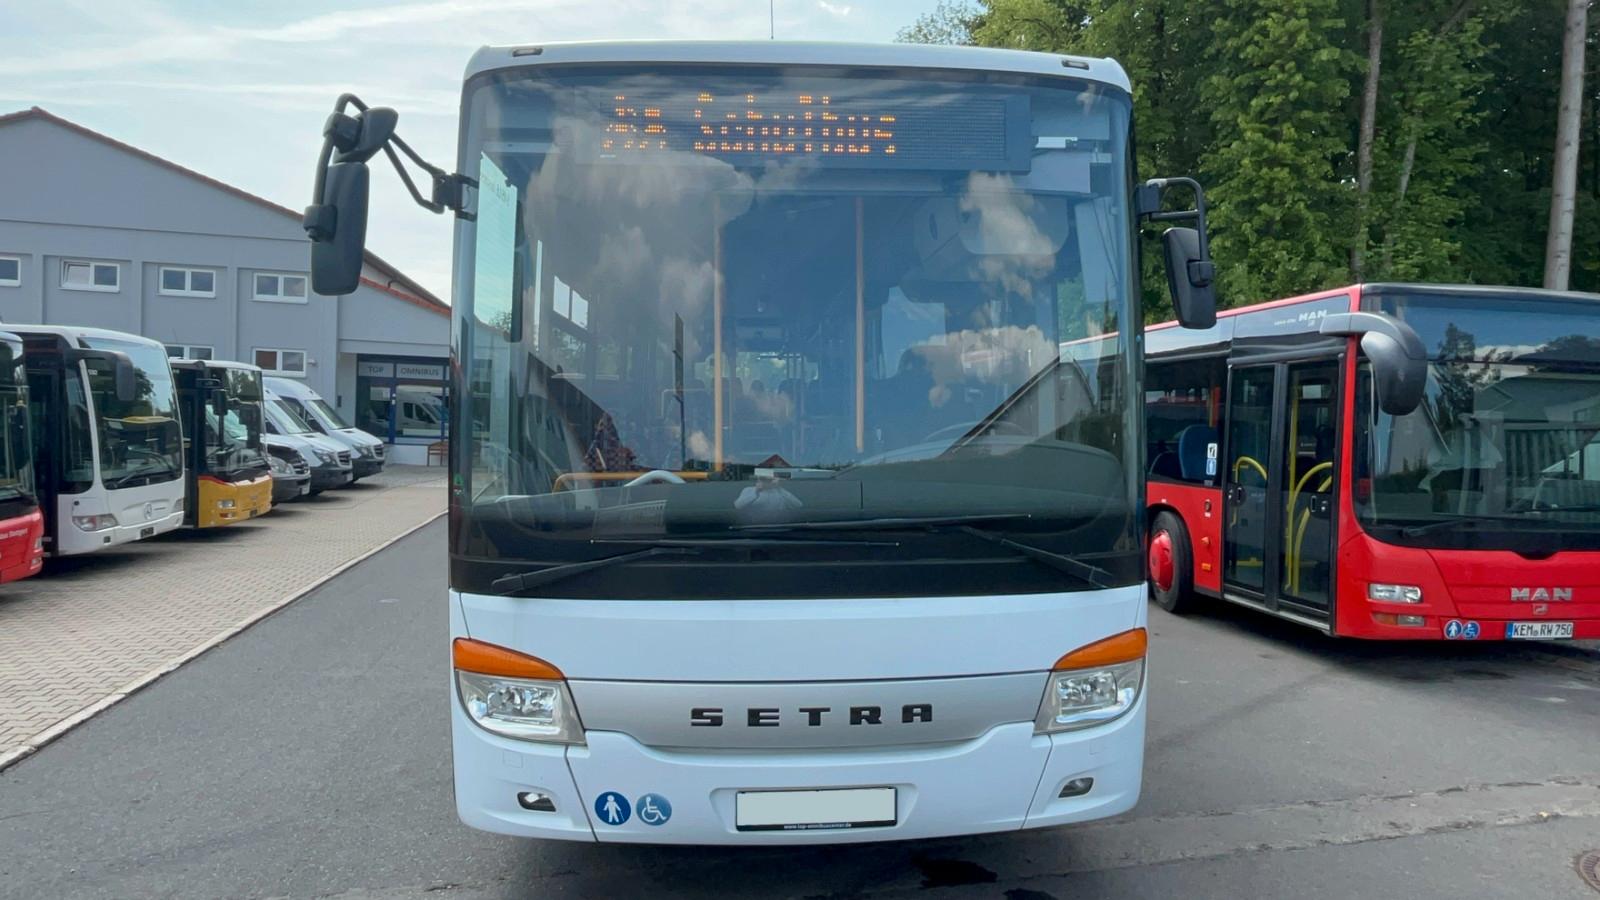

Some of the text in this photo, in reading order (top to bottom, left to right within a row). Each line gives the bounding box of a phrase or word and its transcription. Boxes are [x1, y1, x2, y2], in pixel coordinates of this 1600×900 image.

[1299, 309, 1328, 322] MAN
[400, 367, 439, 377] OMNIBUS
[1510, 587, 1573, 602] MAN
[690, 703, 933, 728] SETRA
